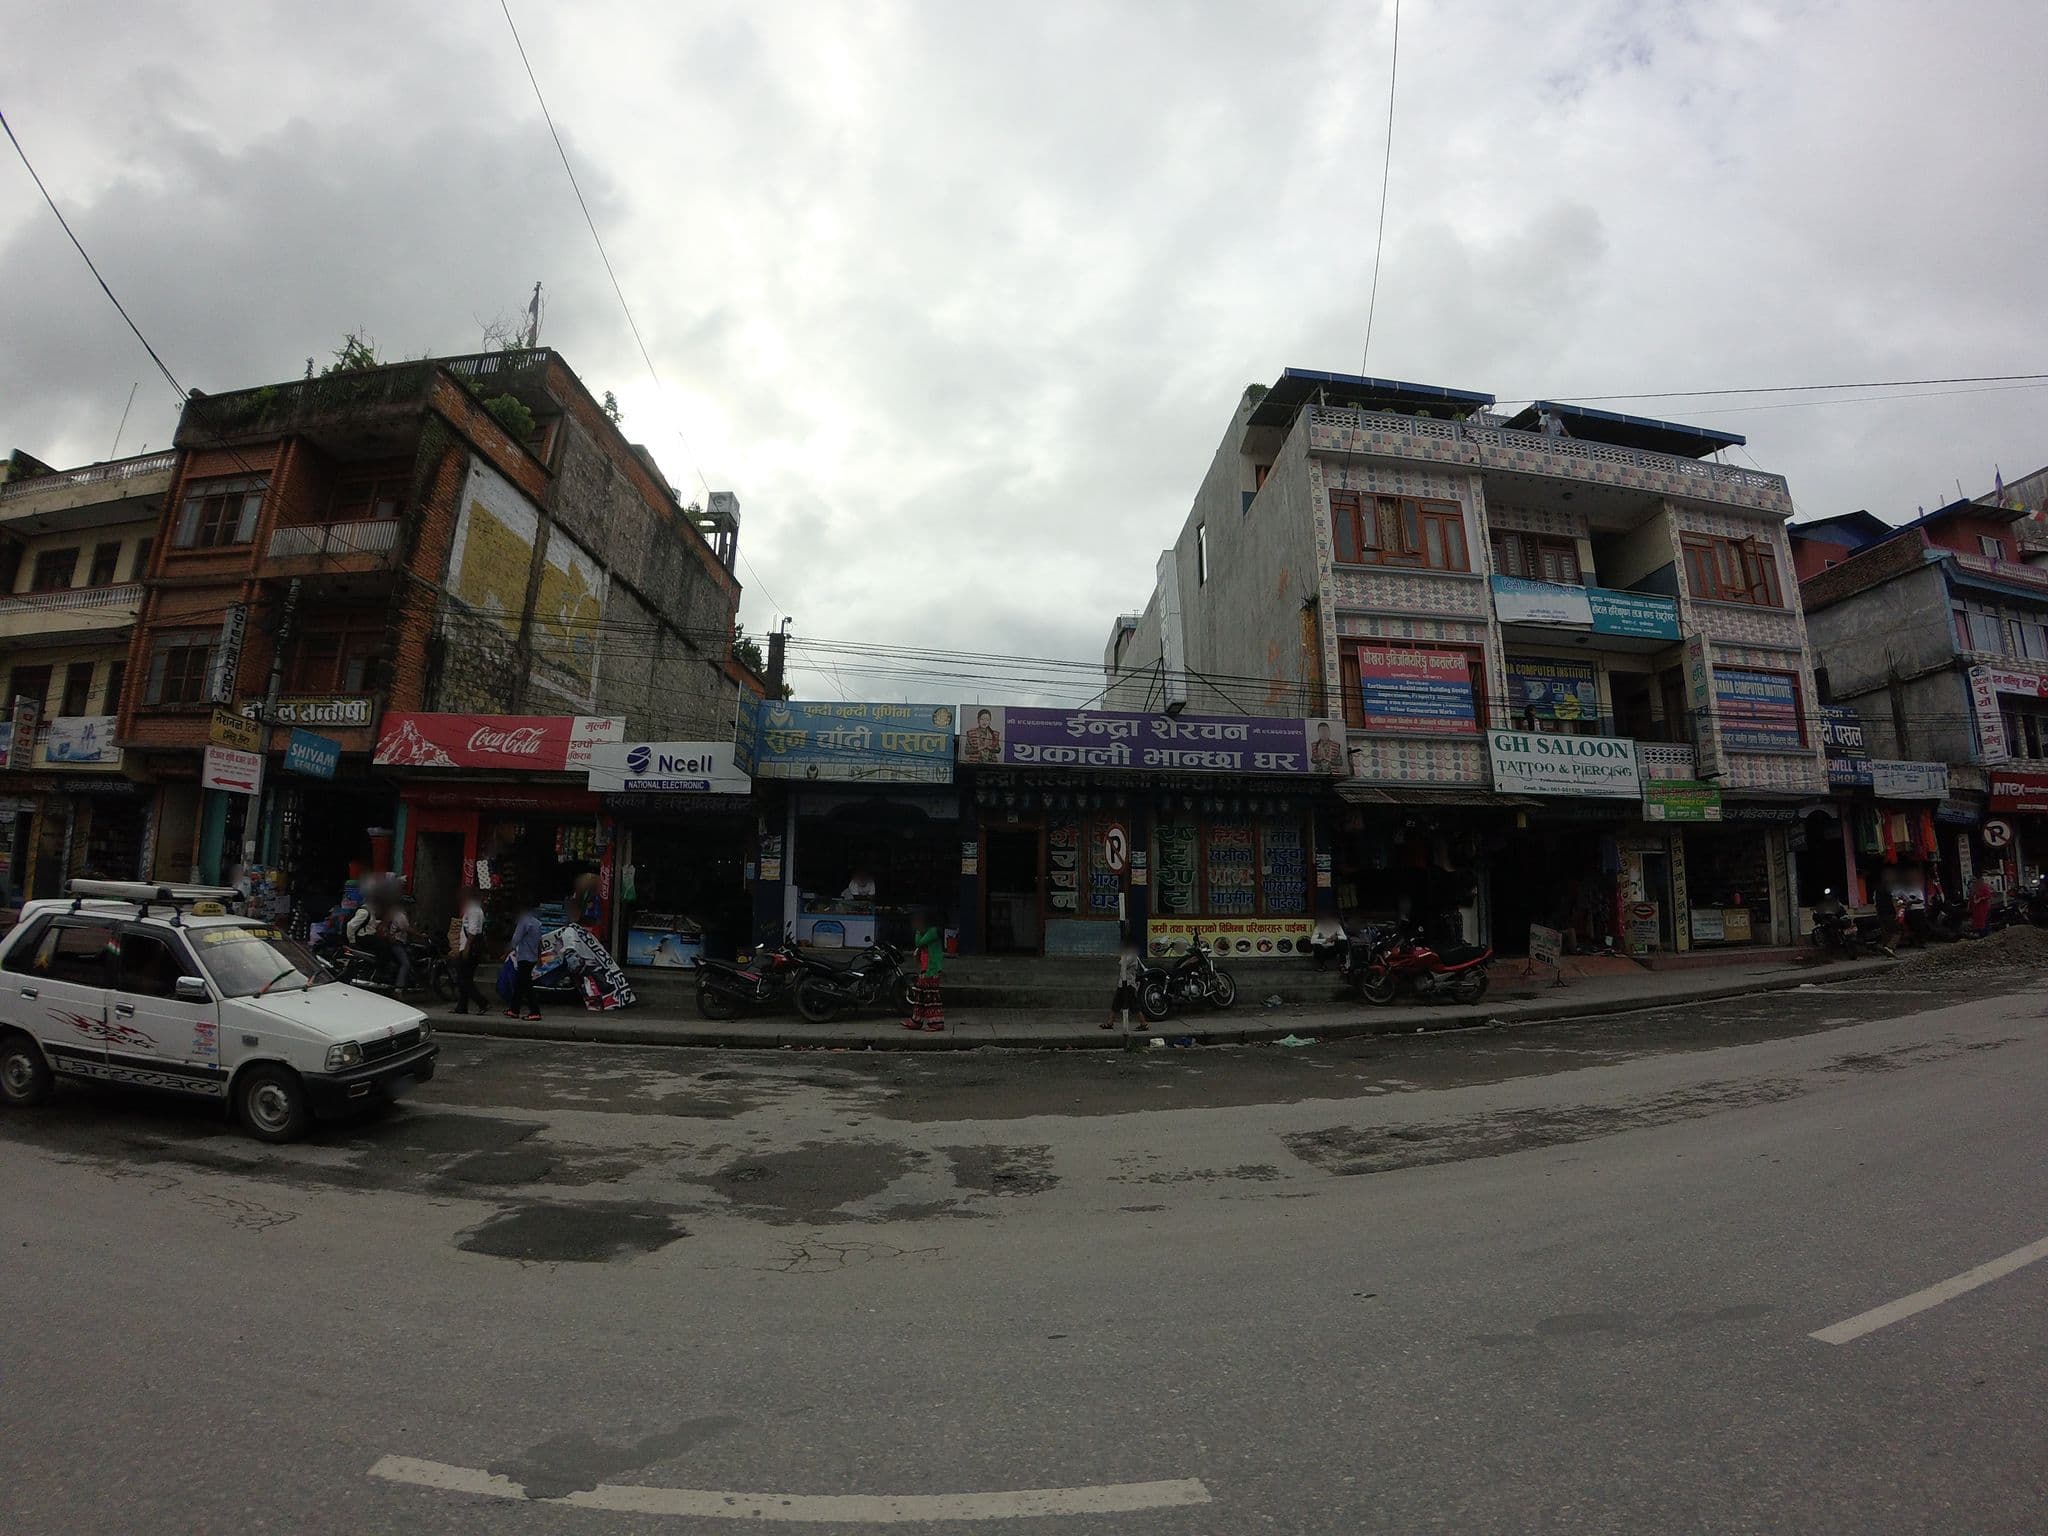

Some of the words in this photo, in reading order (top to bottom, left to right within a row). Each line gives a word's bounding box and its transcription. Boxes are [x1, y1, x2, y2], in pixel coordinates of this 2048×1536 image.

[1515, 664, 1556, 677] COMPUTER
[1556, 667, 1592, 680] INSTITUTE
[299, 700, 368, 723] सन्तोषी
[1065, 713, 1140, 740] ईन्द्रा
[1149, 714, 1249, 742] शेरचन
[1834, 725, 1864, 747] पसल
[763, 730, 809, 754] सुन
[879, 730, 949, 753] पसल
[1494, 735, 1531, 755] GH
[1537, 737, 1629, 762] SALOON
[291, 743, 335, 771] SHIVAM
[658, 754, 713, 774] Ncell
[1013, 741, 1133, 767] थकाली
[1143, 748, 1244, 771] भान्छा
[1254, 752, 1301, 772] घर
[1496, 759, 1555, 778] TATTOO
[1558, 763, 1569, 775] &
[1572, 763, 1632, 781] PIERCING
[1829, 774, 1857, 783] SHOP
[628, 781, 661, 791] NATIONAL
[662, 781, 705, 791] ELECTRONIC
[1151, 922, 1168, 933] खसी
[1169, 924, 1184, 933] तथा
